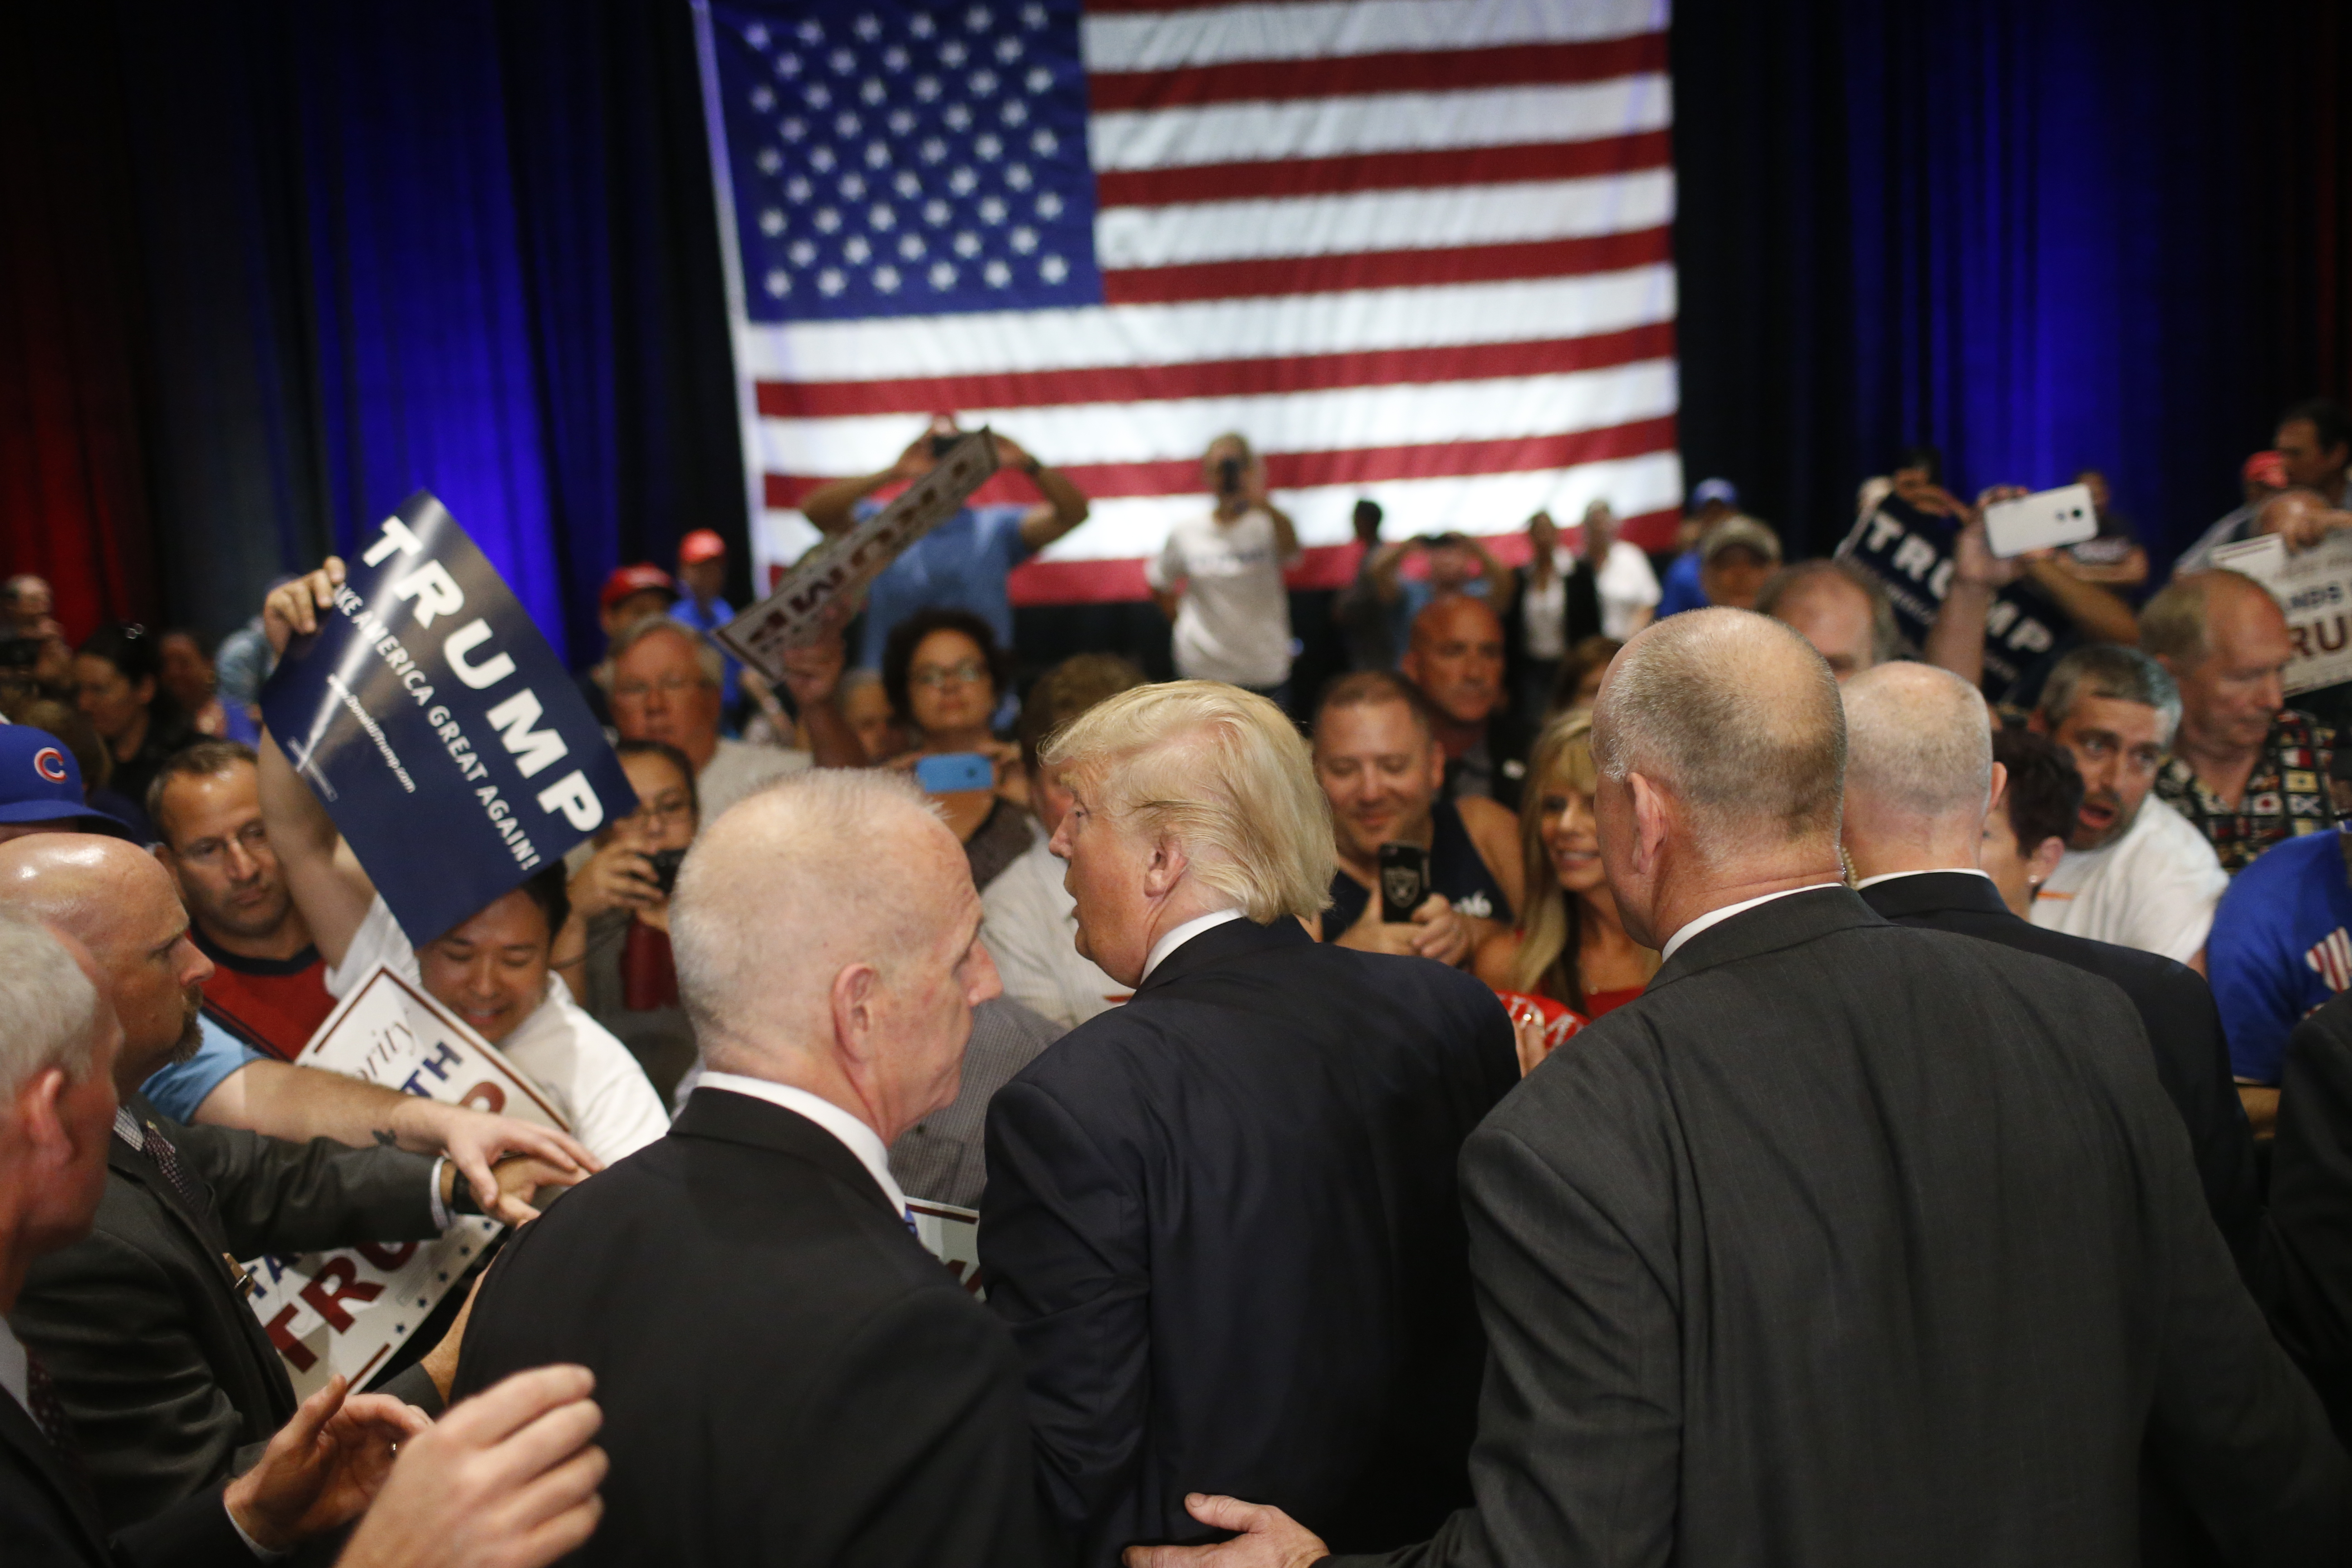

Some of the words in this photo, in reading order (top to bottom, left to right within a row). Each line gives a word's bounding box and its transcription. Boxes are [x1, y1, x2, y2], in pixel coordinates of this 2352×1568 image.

[34, 747, 67, 784] C
[352, 610, 435, 706] AMERICA
[428, 705, 489, 782] GREAT
[475, 785, 541, 871] AGAIN!
[363, 516, 604, 832] TRUMP
